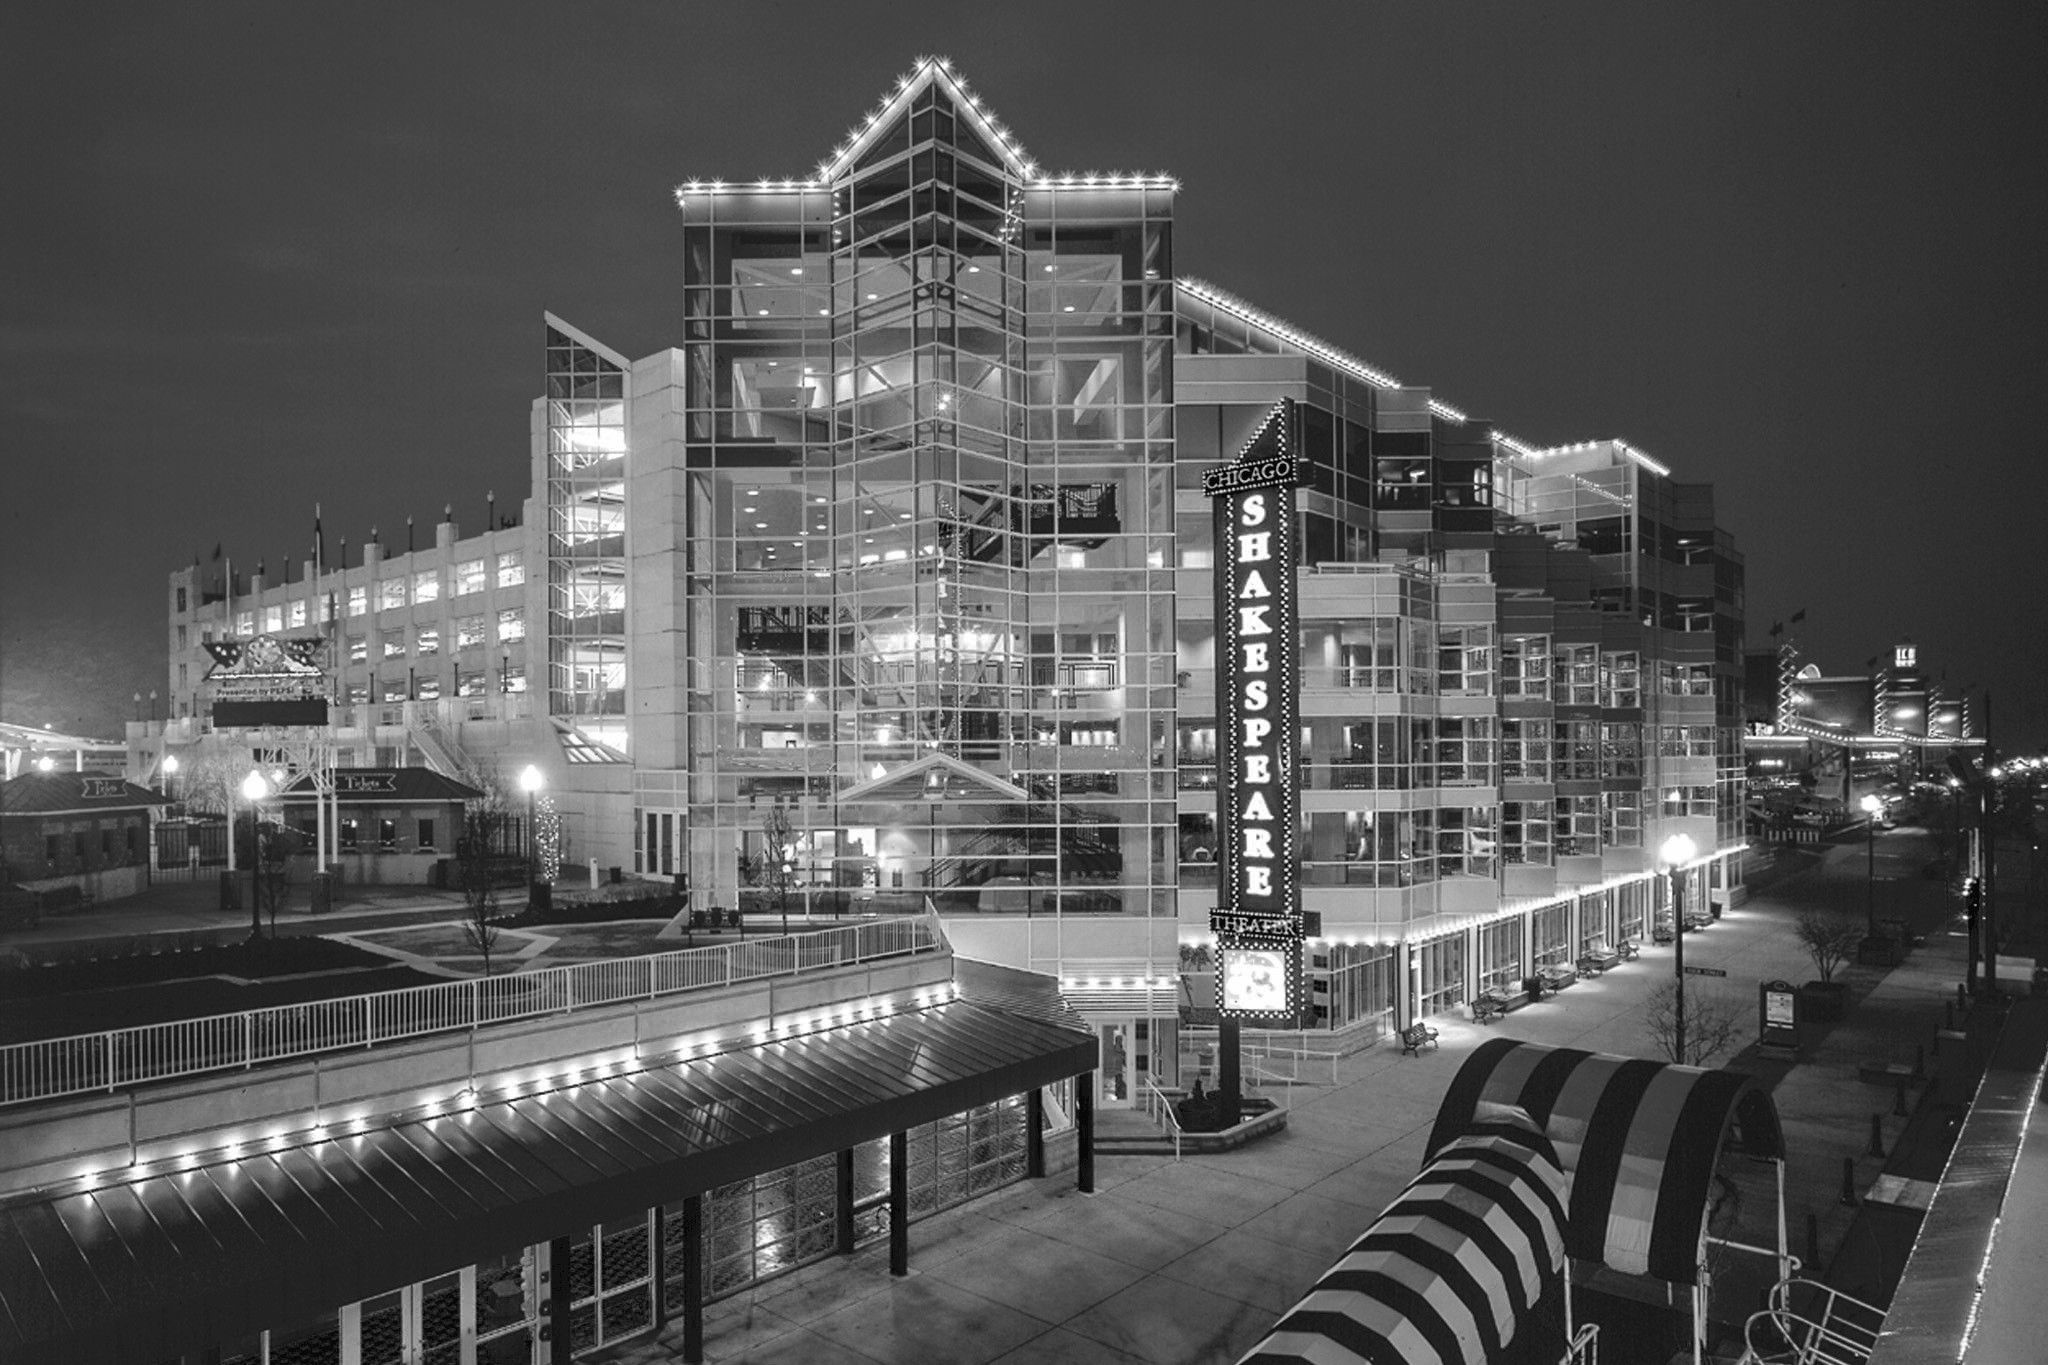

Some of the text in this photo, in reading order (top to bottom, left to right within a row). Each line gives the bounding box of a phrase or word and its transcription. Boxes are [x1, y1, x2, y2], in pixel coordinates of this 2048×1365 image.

[1205, 461, 1290, 489] CHICAGO
[1238, 494, 1275, 896] SHAKESPEARE
[1211, 915, 1297, 936] THEATER
